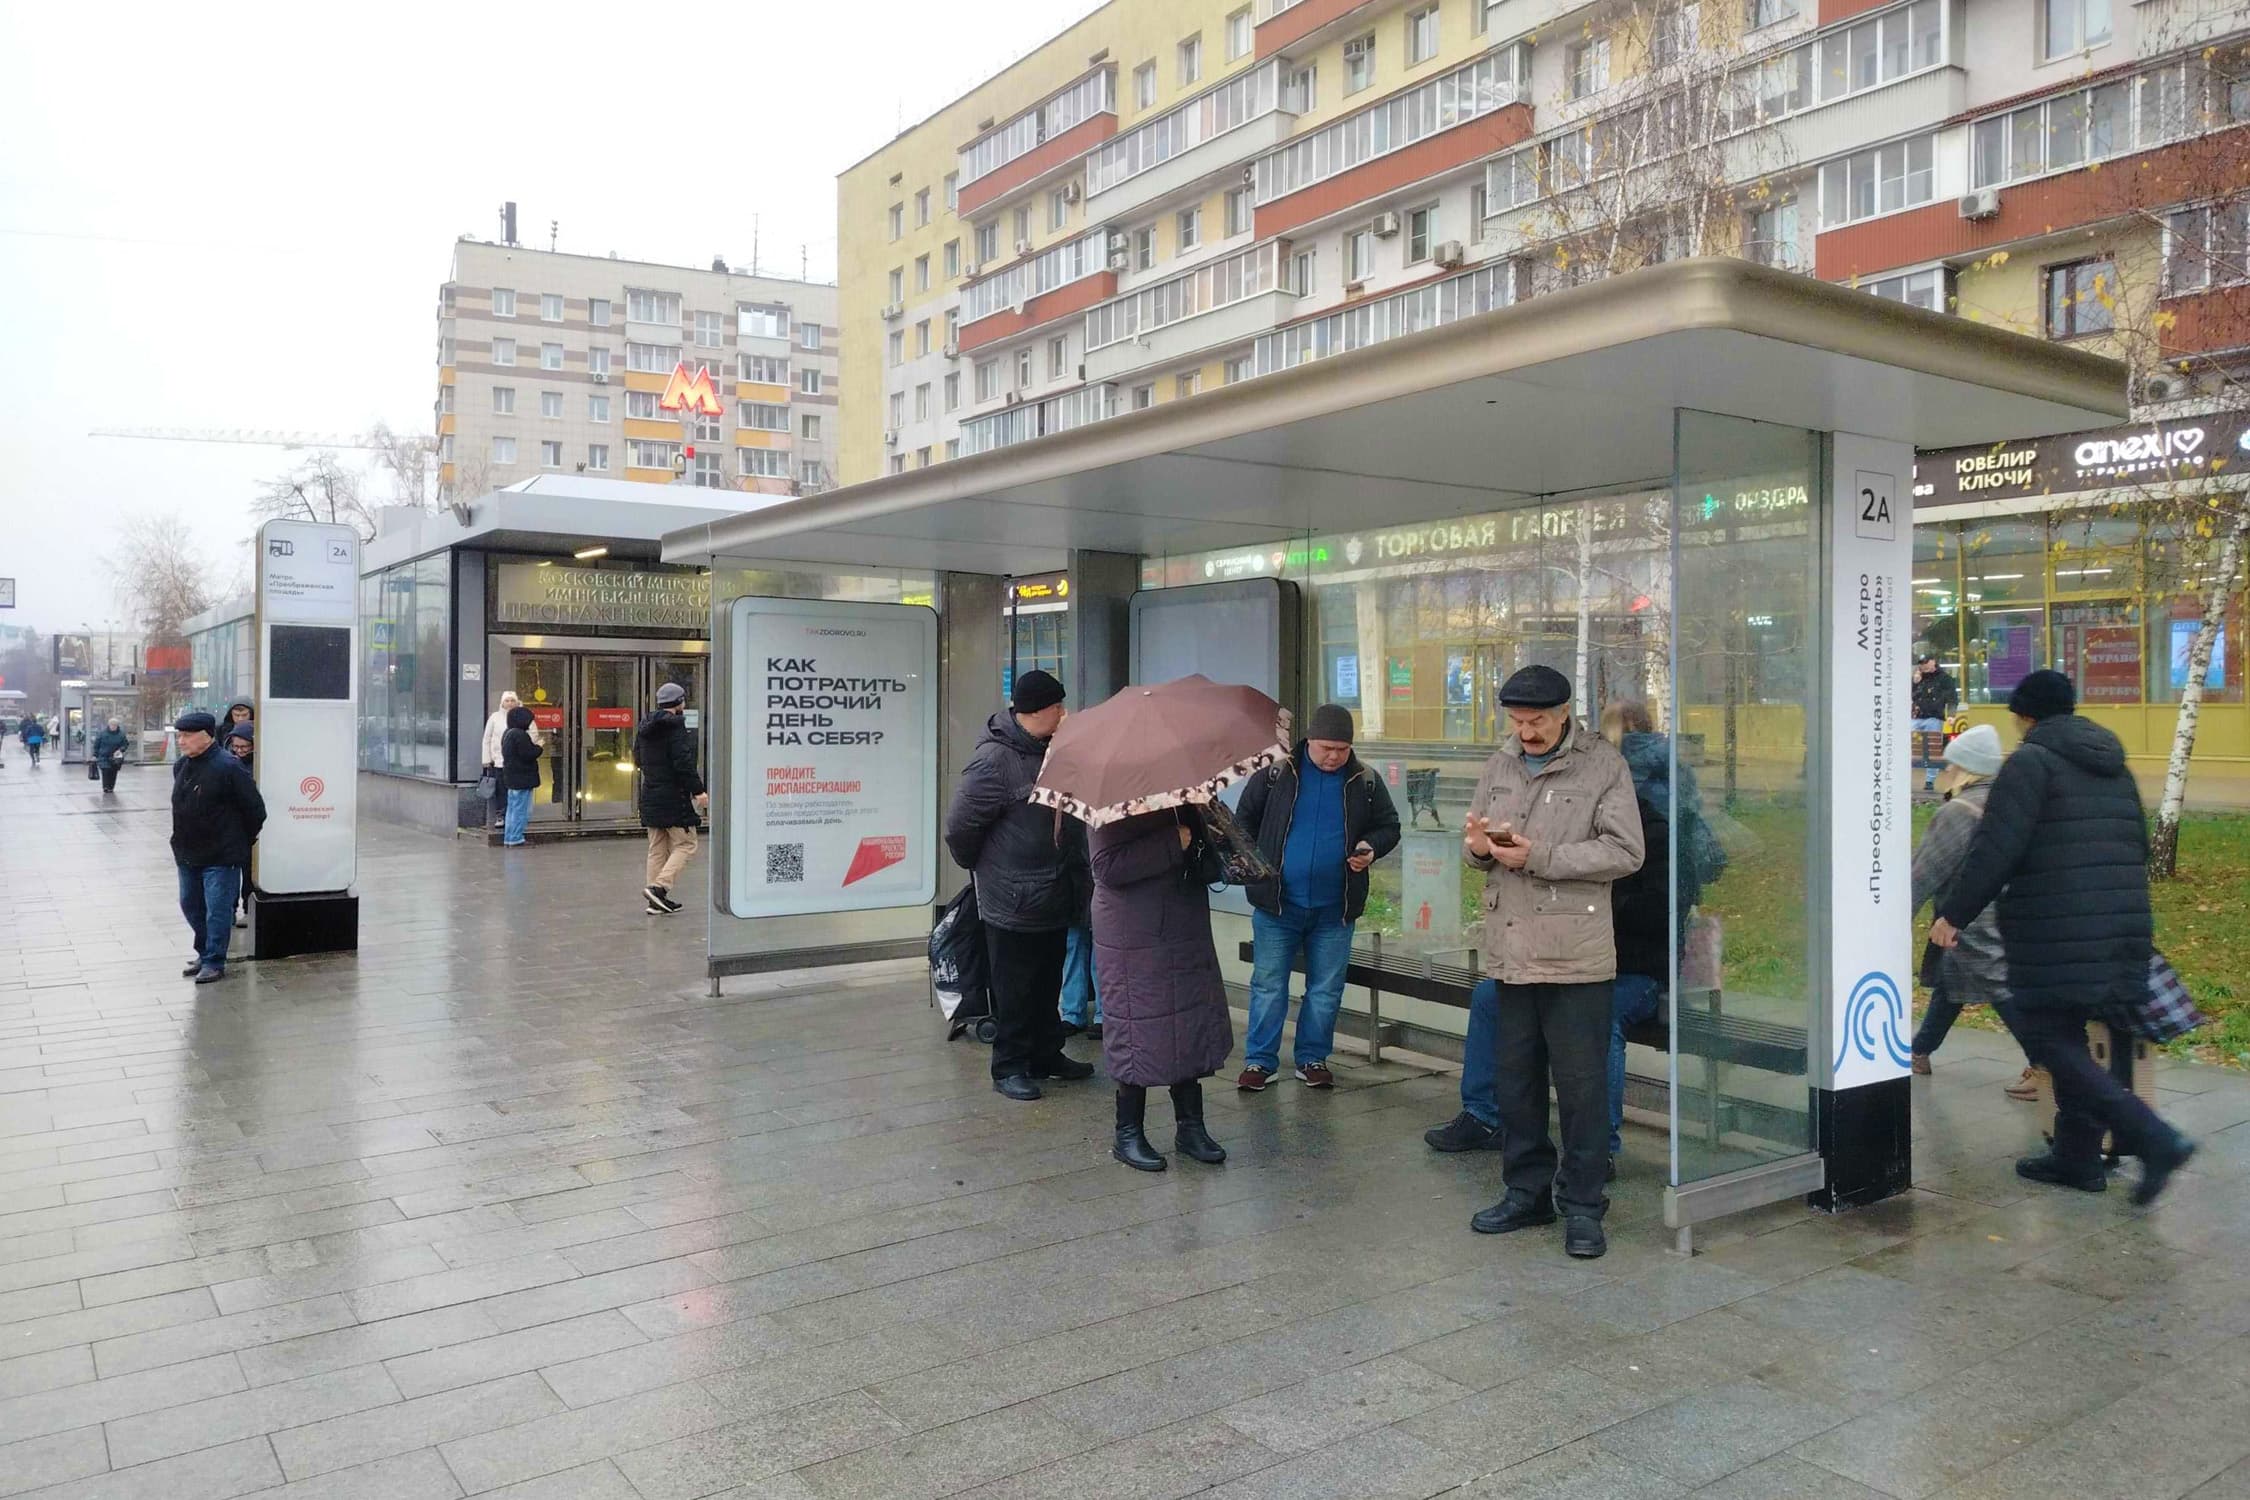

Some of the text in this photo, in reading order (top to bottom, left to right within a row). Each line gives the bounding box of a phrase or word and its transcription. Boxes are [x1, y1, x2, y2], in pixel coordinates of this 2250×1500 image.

[660, 361, 723, 416] М
[2075, 433, 2163, 466] anex
[1955, 450, 2037, 474] ЮВЕЛИР
[1958, 468, 2032, 492] КЛЮЧИ
[1861, 488, 1890, 523] 2А
[1374, 520, 1496, 558] ТОРГОВАЯ
[333, 546, 347, 557] 2А
[538, 571, 645, 589] МОСКОВСКИЙ
[1857, 573, 1871, 651] Метро
[767, 658, 816, 673] КАК
[767, 676, 907, 692] ПОТРАТИТЬ
[767, 693, 881, 710] РАБОЧИЙ
[766, 713, 833, 729] ДЕНЬ
[767, 731, 884, 746] НА СЕБЯ?
[1869, 575, 1884, 905] «Преображенская площадь»
[766, 766, 816, 780] ПРОЙДИТЕ
[766, 781, 862, 796] ДИСПАНСЕРИЗАЦИЮ
[1884, 786, 1893, 832] Metro
[766, 816, 823, 826] оплачиваемый
